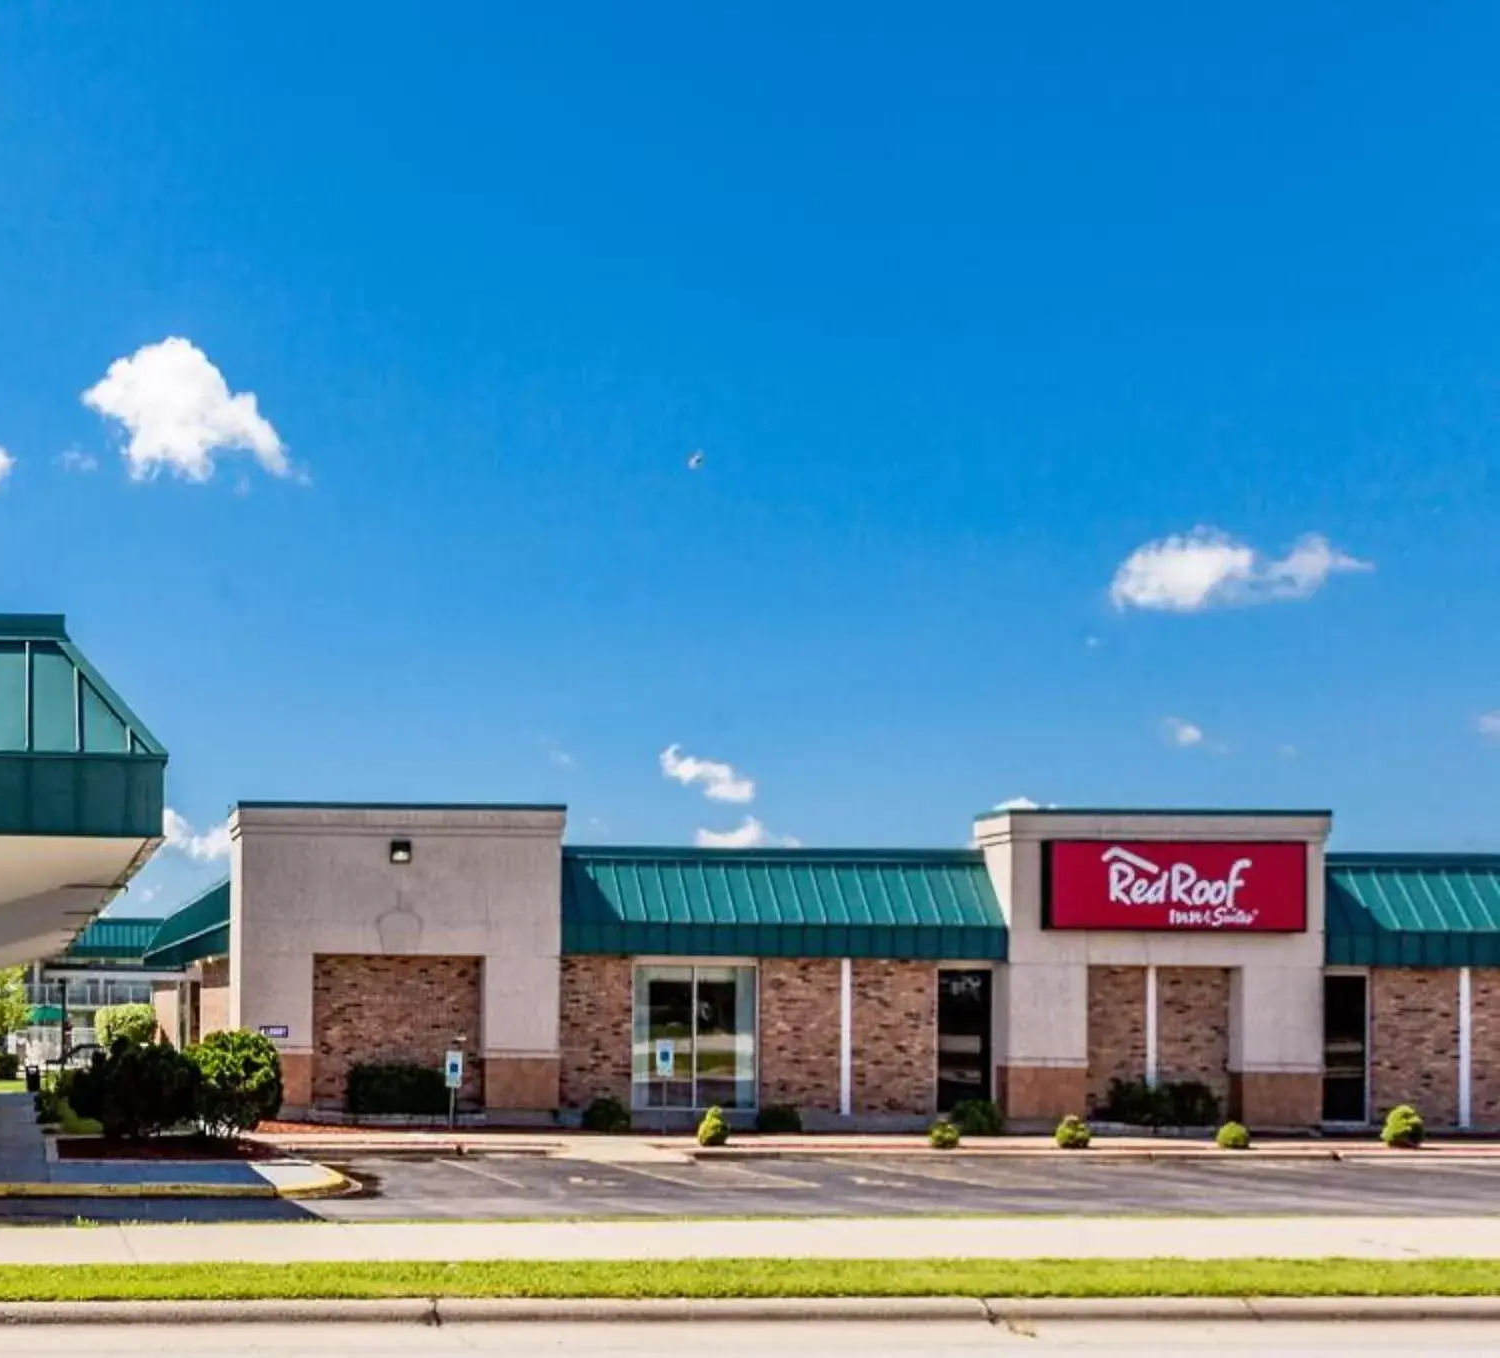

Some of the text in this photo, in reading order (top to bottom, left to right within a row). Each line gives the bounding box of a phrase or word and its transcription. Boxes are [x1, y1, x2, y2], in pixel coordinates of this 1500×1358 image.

[1109, 858, 1252, 908] Red Roof
[1169, 908, 1202, 925] Inn
